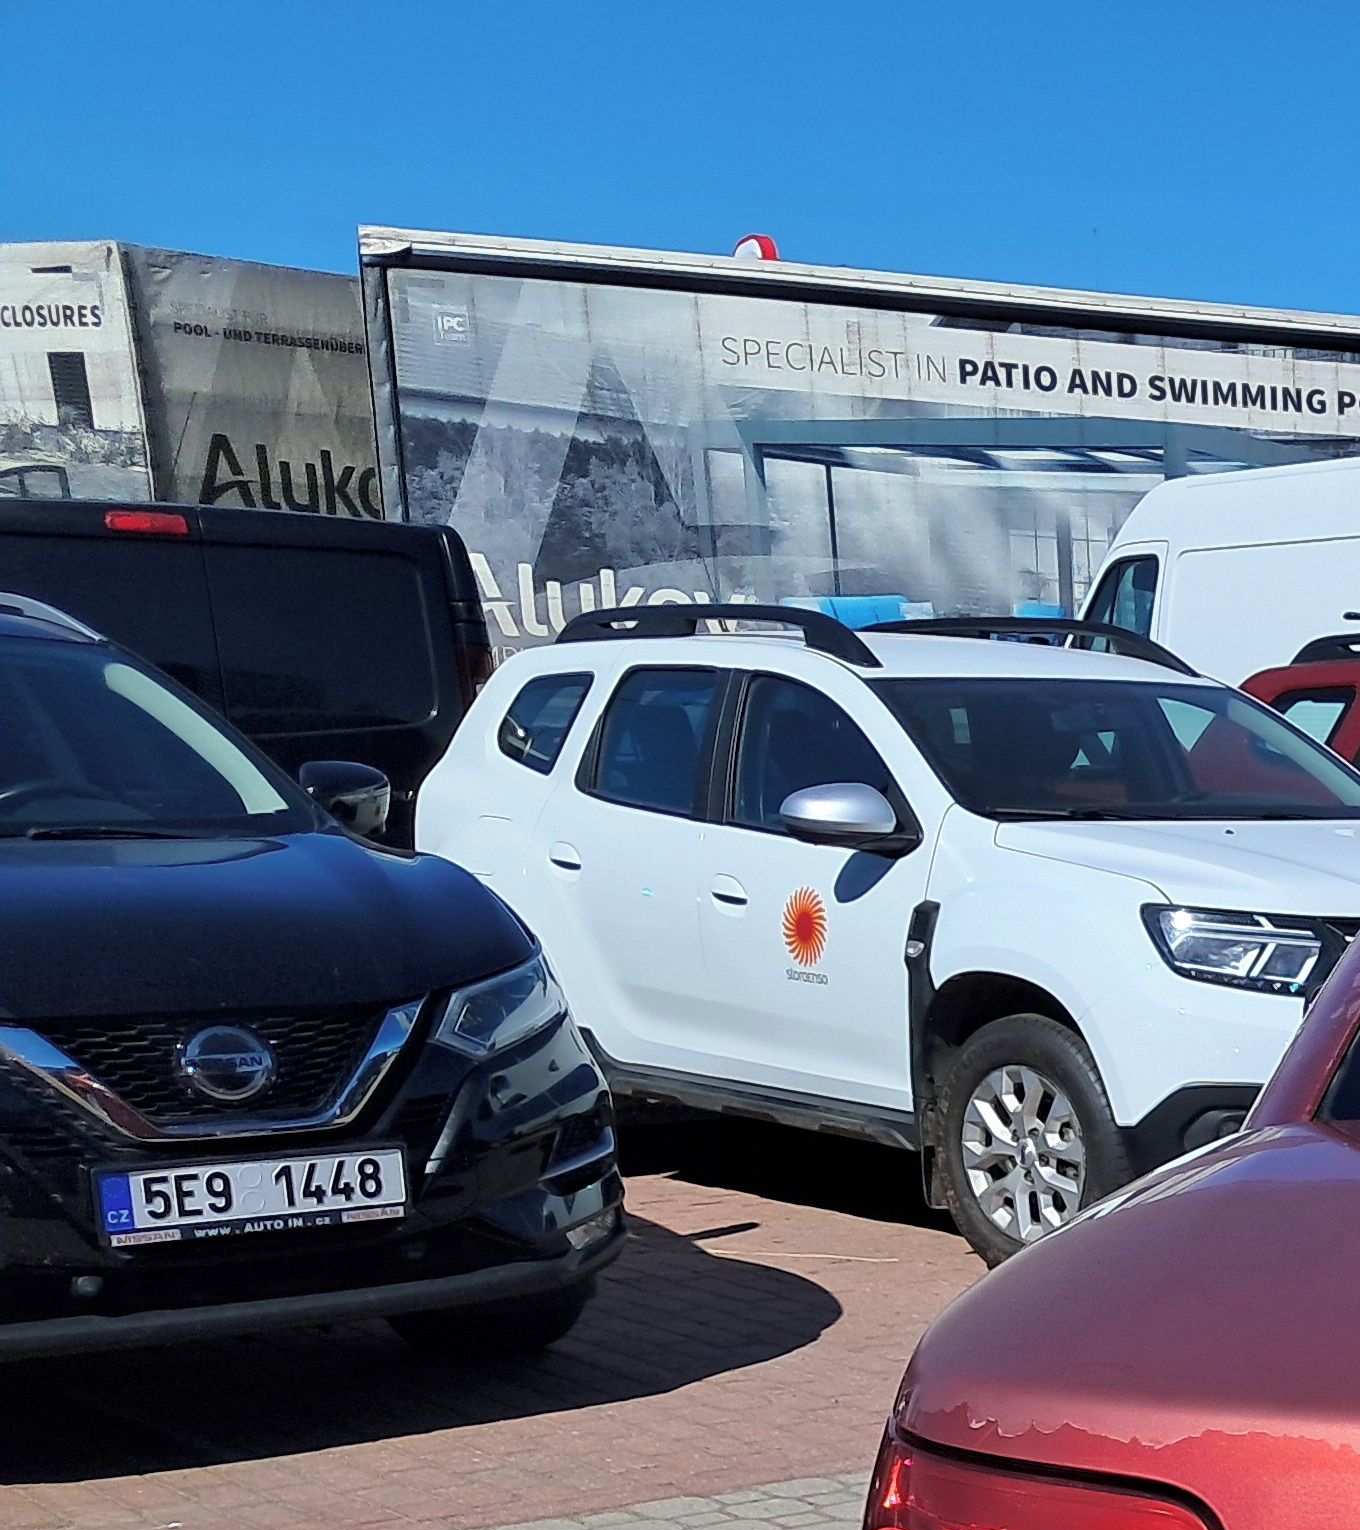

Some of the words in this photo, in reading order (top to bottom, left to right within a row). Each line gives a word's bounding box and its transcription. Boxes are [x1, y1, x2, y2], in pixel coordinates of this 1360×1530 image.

[0, 304, 103, 328] CLOSURES
[222, 327, 252, 342] UND
[720, 336, 905, 380] SPECIALIST
[917, 353, 947, 383] IN
[958, 357, 1058, 393] PATIO
[1067, 367, 1138, 399] AND
[1147, 374, 1327, 415] SWIMMING
[141, 1171, 233, 1220] 5E9
[272, 1157, 383, 1208] 1448
[107, 1209, 130, 1225] CZ
